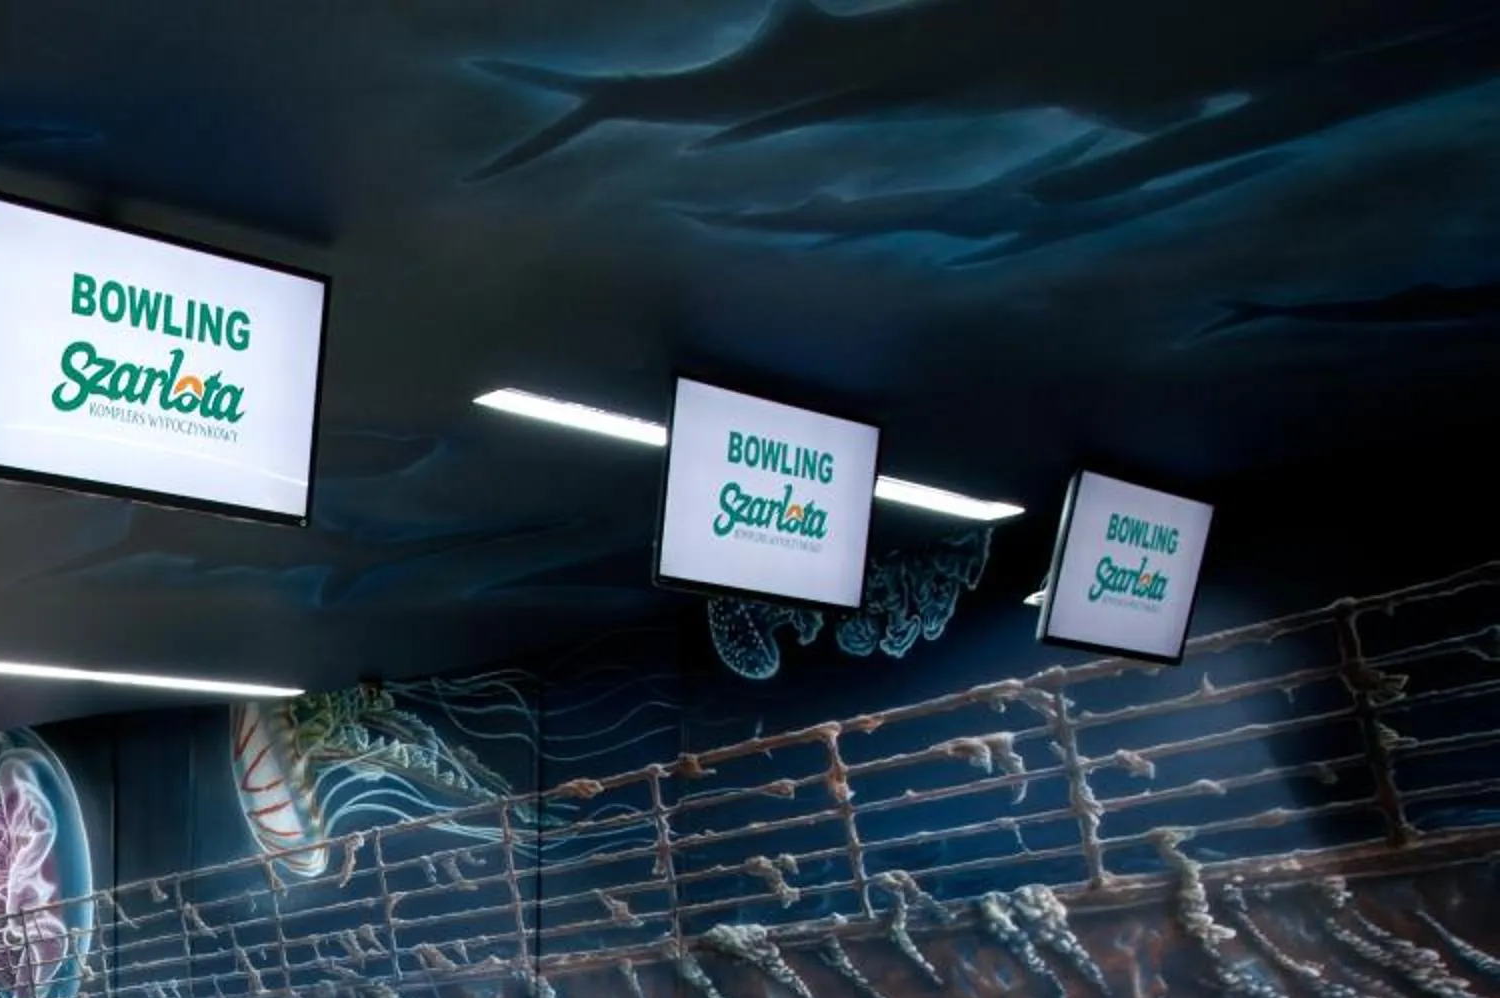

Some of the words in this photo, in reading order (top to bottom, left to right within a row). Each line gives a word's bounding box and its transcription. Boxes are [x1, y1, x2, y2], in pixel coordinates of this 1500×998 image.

[70, 272, 252, 352] BOWLING
[51, 340, 246, 424] Szarlota
[727, 431, 835, 484] BOWLING
[712, 481, 830, 540] Szarlota
[1106, 513, 1180, 555] BOWLING
[1088, 555, 1169, 602] Szarlota
